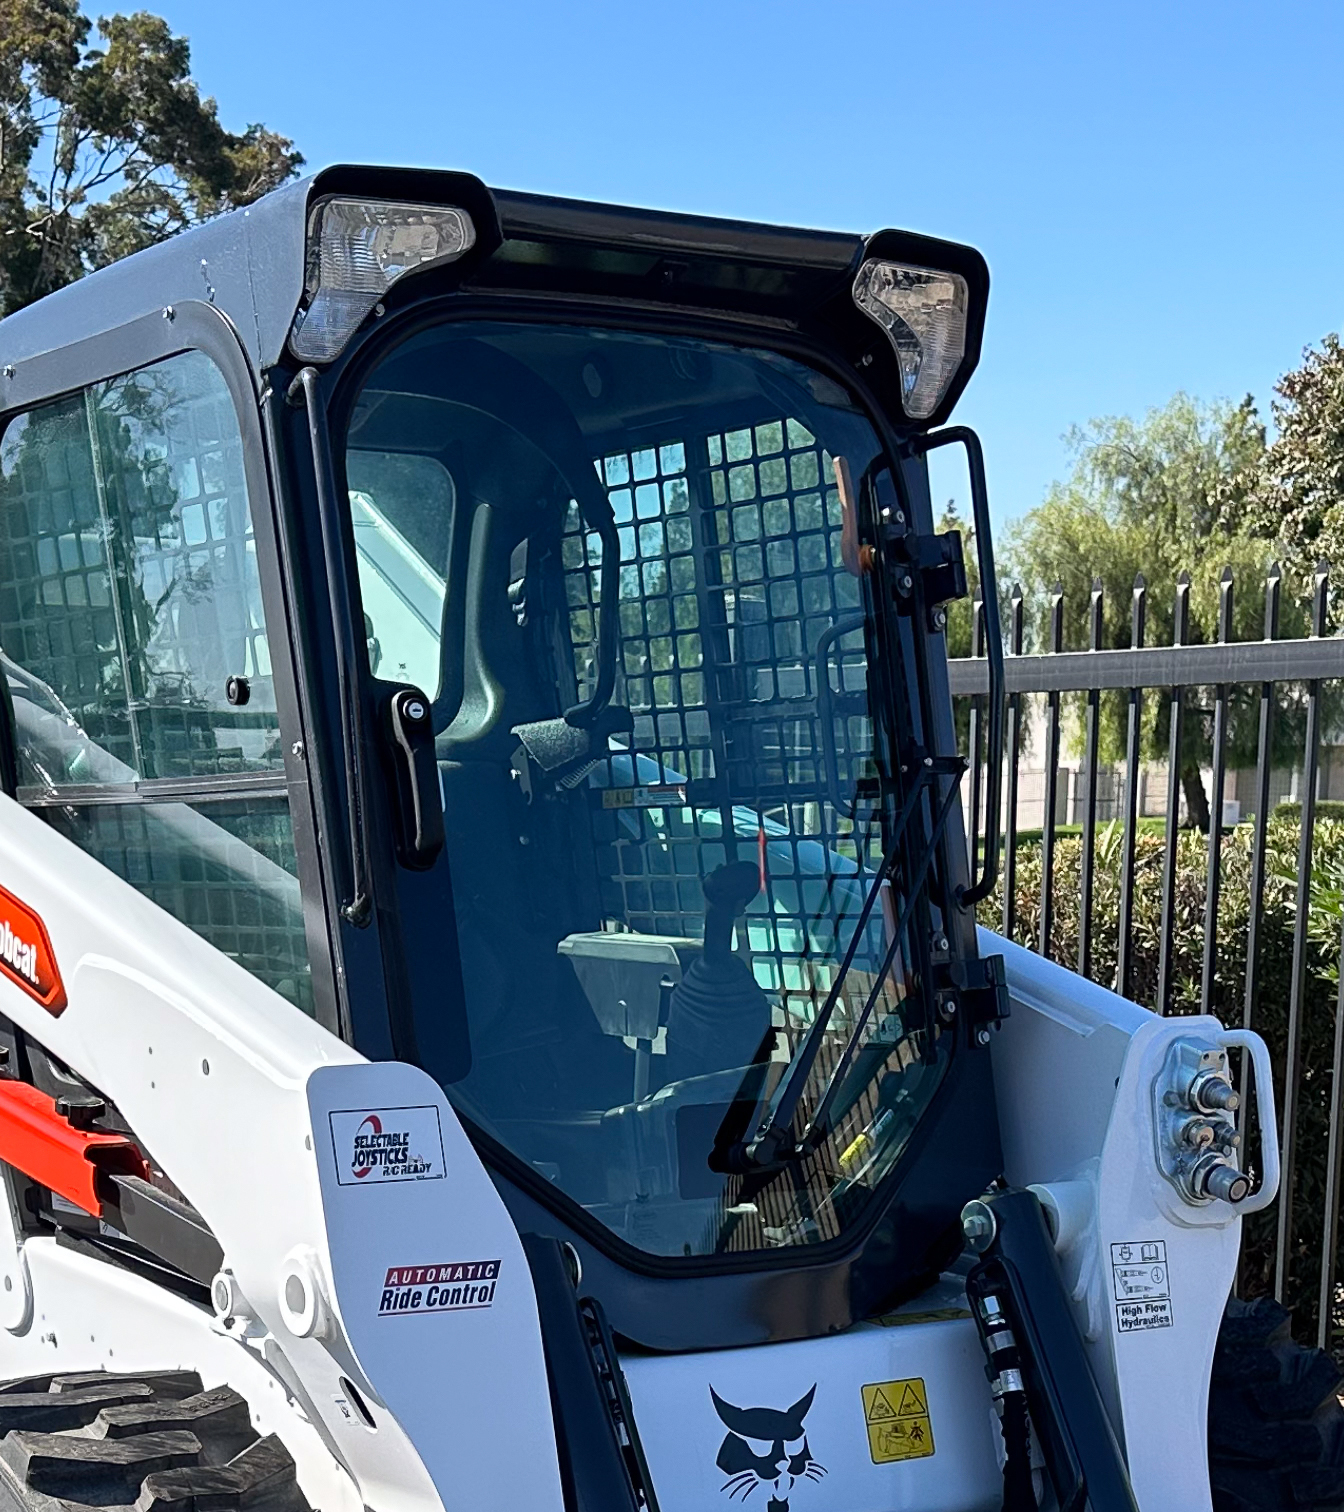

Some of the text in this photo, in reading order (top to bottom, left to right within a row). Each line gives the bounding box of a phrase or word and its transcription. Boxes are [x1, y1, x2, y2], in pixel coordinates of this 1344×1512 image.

[354, 1132, 409, 1149] SELECTABLE
[351, 1147, 409, 1168] JOYSTICKS
[401, 1162, 432, 1176] READY
[388, 1263, 495, 1285] AUTOMATIC
[379, 1280, 497, 1311] Ride Control
[1121, 1303, 1167, 1317] High Flow
[1121, 1314, 1170, 1329] Hydraulics
